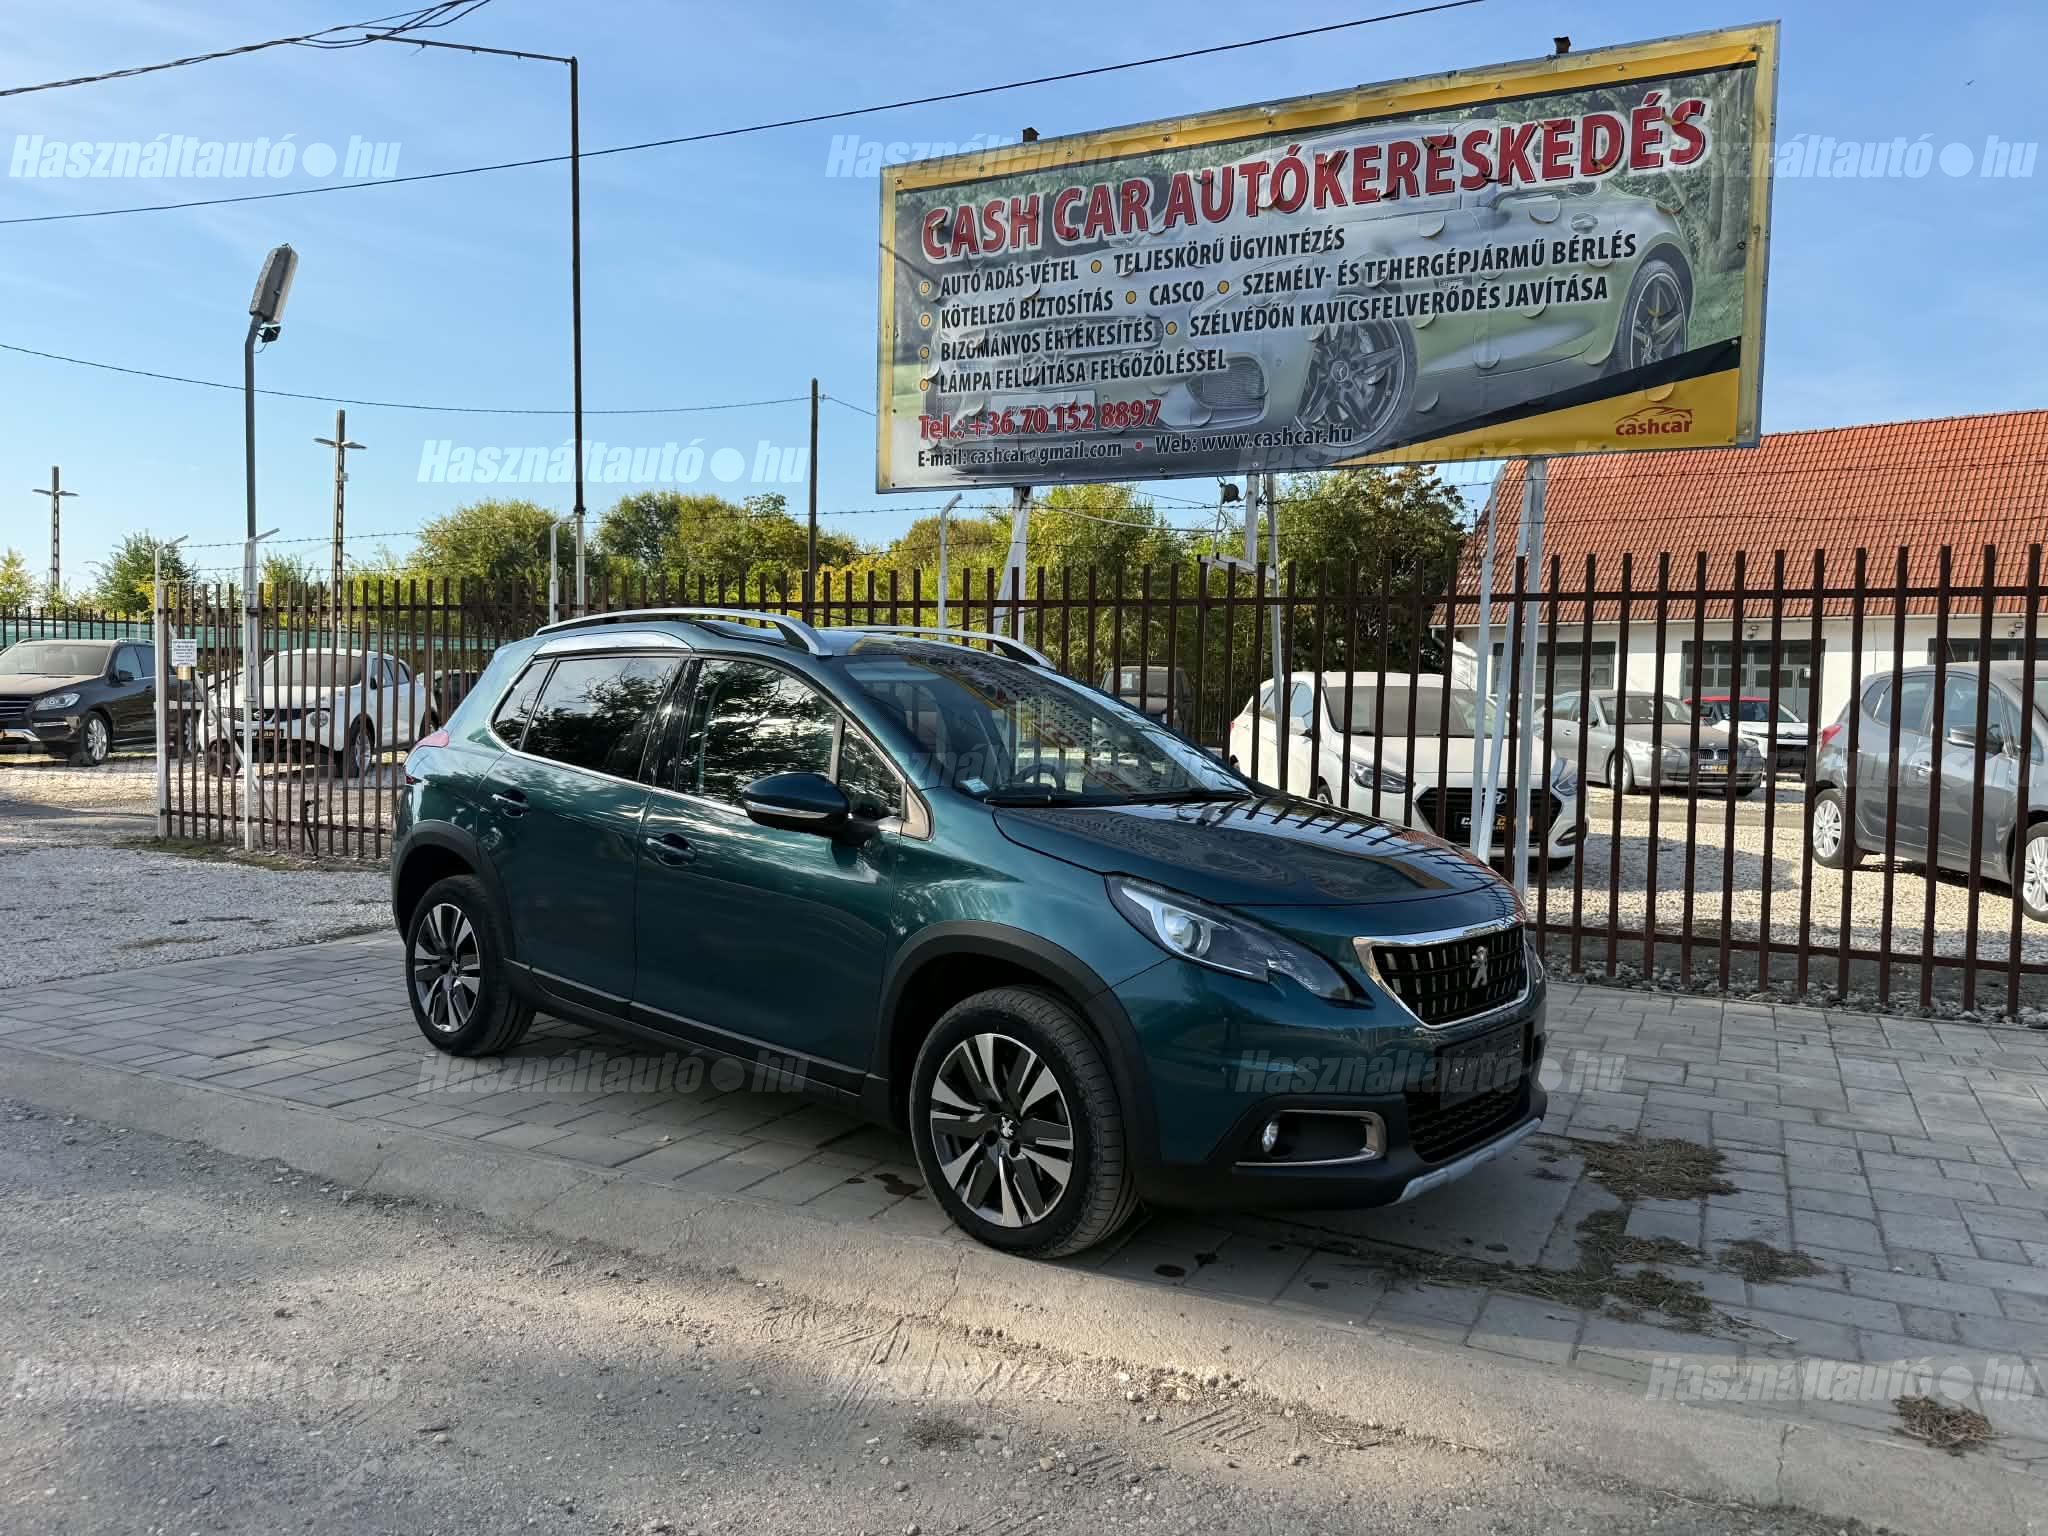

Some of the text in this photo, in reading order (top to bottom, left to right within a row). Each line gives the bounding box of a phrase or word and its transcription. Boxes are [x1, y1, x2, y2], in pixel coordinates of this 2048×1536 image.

[922, 92, 1705, 259] CASH CAR AUTÓKERESKEDÉS
[941, 225, 1345, 296] AUTÓ ADÁS-VÉTEL TELJESKÖRŰ ÜGYINTÉZÉS
[941, 230, 1636, 329] KÖTELEZŐ BIZTOSÍTÁS CASCO SZEMÉLY- ÉS TEHERGÉPJÁRMŰ BÉRLÉS
[1046, 317, 1153, 352] ÉRTÉKESÍTÉS
[1190, 305, 1295, 338] SZÉLVÉDŐN
[1300, 283, 1501, 327] KAVICSFELVERŐDÉS
[1505, 274, 1608, 309] JAVÍTÁSA
[940, 349, 1227, 393] LÁMPA FELÚJÍTÁSA FELGŐZÖLÉSSEL
[918, 399, 1161, 439] Tel.: +36 70 152 8897
[918, 424, 1353, 467] E-mail: cashcar@gmail.com Web: www.cashcar.hu
[1615, 418, 1690, 436] cashcar
